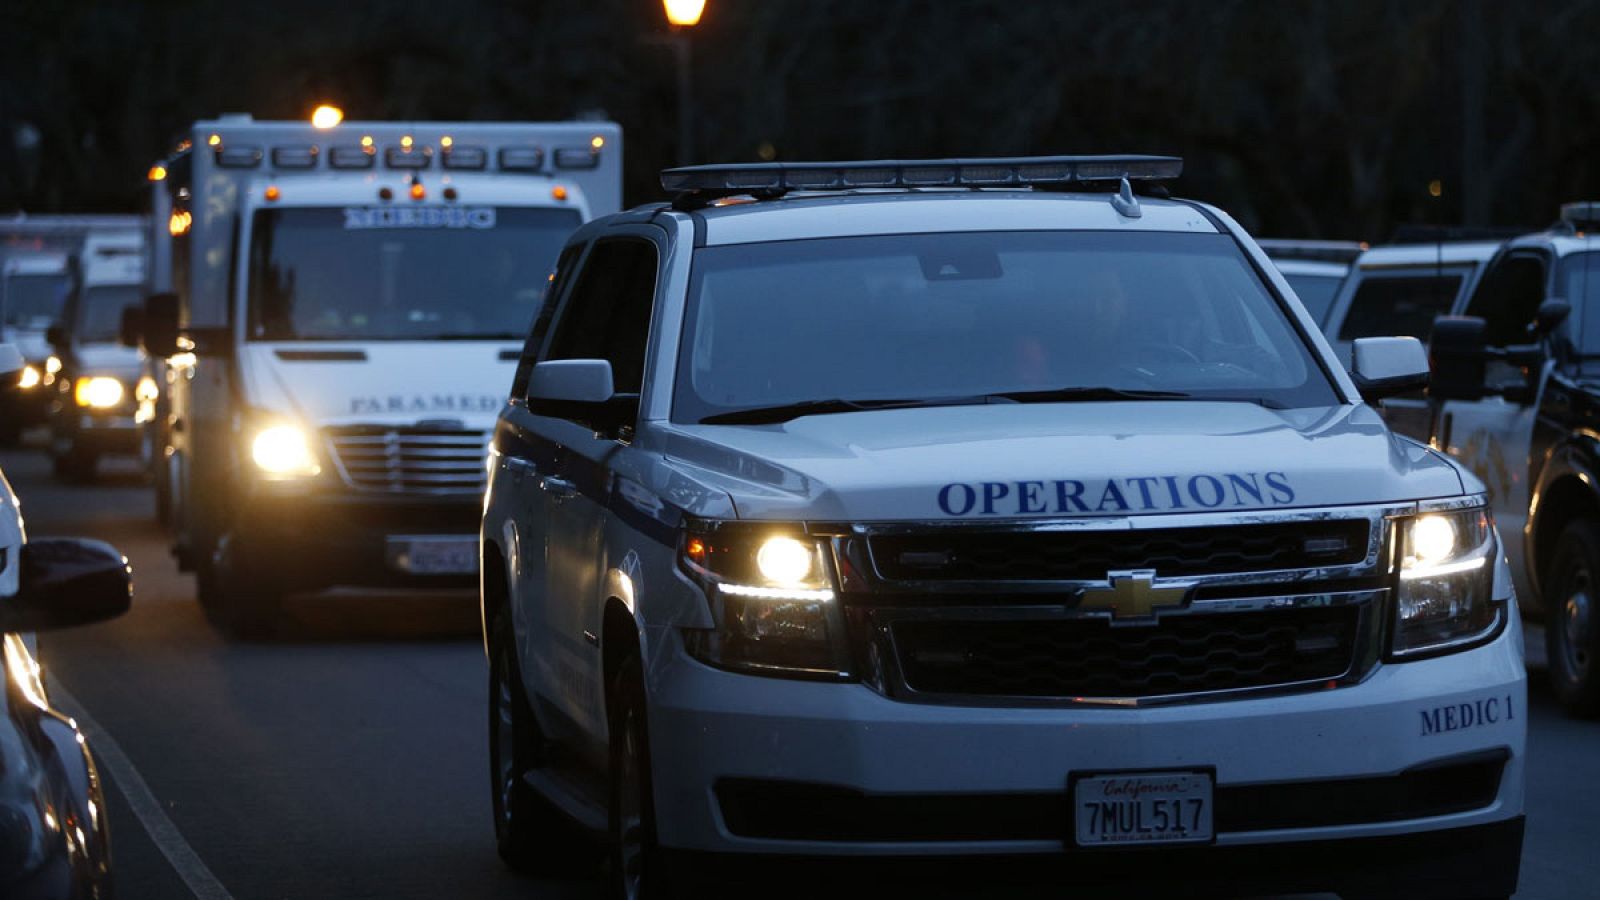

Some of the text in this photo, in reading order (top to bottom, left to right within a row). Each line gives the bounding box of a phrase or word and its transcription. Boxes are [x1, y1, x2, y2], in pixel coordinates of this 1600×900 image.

[344, 206, 496, 229] MEDIC
[938, 471, 1296, 516] OPERATIONS
[1420, 695, 1513, 736] MEDIC 1
[1104, 779, 1187, 798] California
[1085, 798, 1203, 834] 7MUL517
